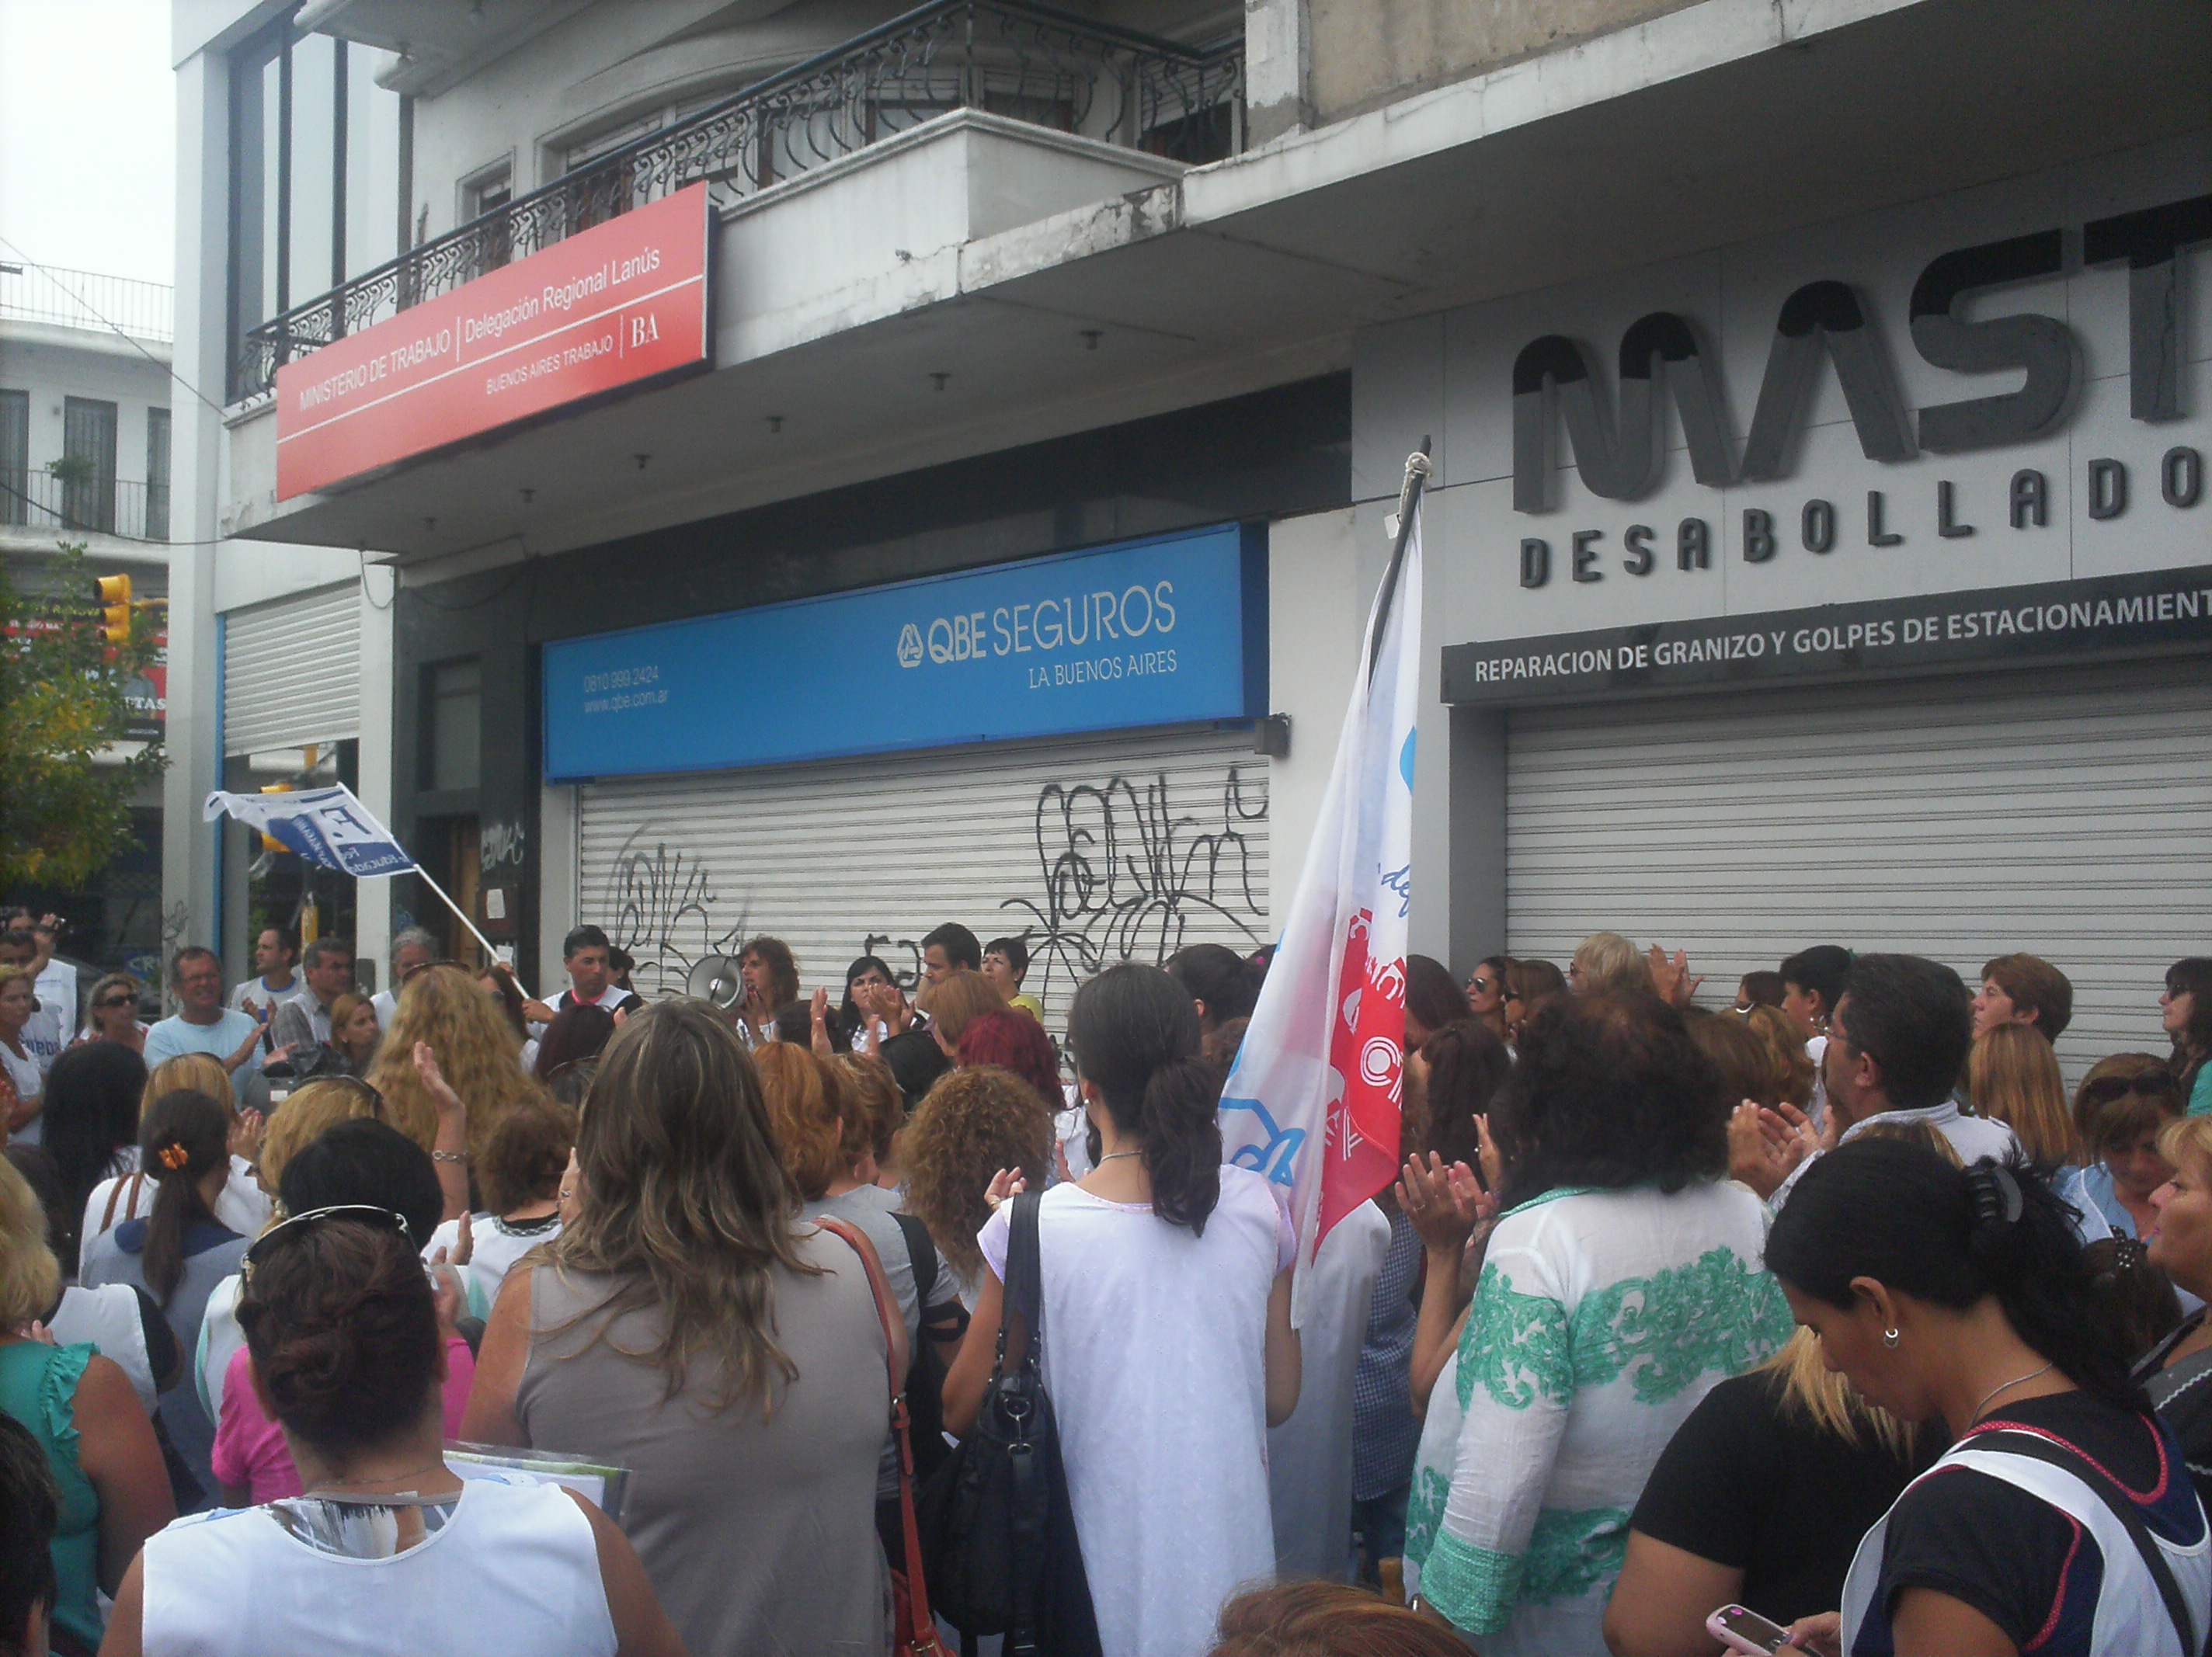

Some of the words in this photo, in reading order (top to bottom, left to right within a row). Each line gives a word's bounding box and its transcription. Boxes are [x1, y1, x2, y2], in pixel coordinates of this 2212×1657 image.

[465, 296, 538, 343] Delegación
[543, 263, 607, 312] Regional
[612, 246, 660, 285] Lanús
[631, 311, 659, 348] BA
[300, 364, 367, 412] MINISTERIO
[370, 356, 388, 374] DE
[391, 328, 450, 373] TRABAJO
[486, 366, 527, 394] BUENOS
[529, 354, 561, 380] AIRES
[563, 335, 614, 366] TRABAJO
[927, 611, 987, 664] QBE
[993, 581, 1176, 656] SEGUROS
[1476, 648, 1612, 682] REPARACION
[1618, 644, 1647, 669] DE
[1654, 633, 1765, 666] GRANIZO
[1771, 630, 1786, 654] Y
[1793, 621, 1895, 654] GOLPES
[1903, 616, 1939, 644] DE
[584, 672, 609, 693] 0810
[611, 669, 631, 688] 999
[633, 666, 659, 685] 2424
[1029, 667, 1050, 689] LA
[1056, 658, 1123, 686] BUENOS
[1126, 649, 1177, 677] AIRES
[584, 690, 669, 713] www.qbe.com.ar
